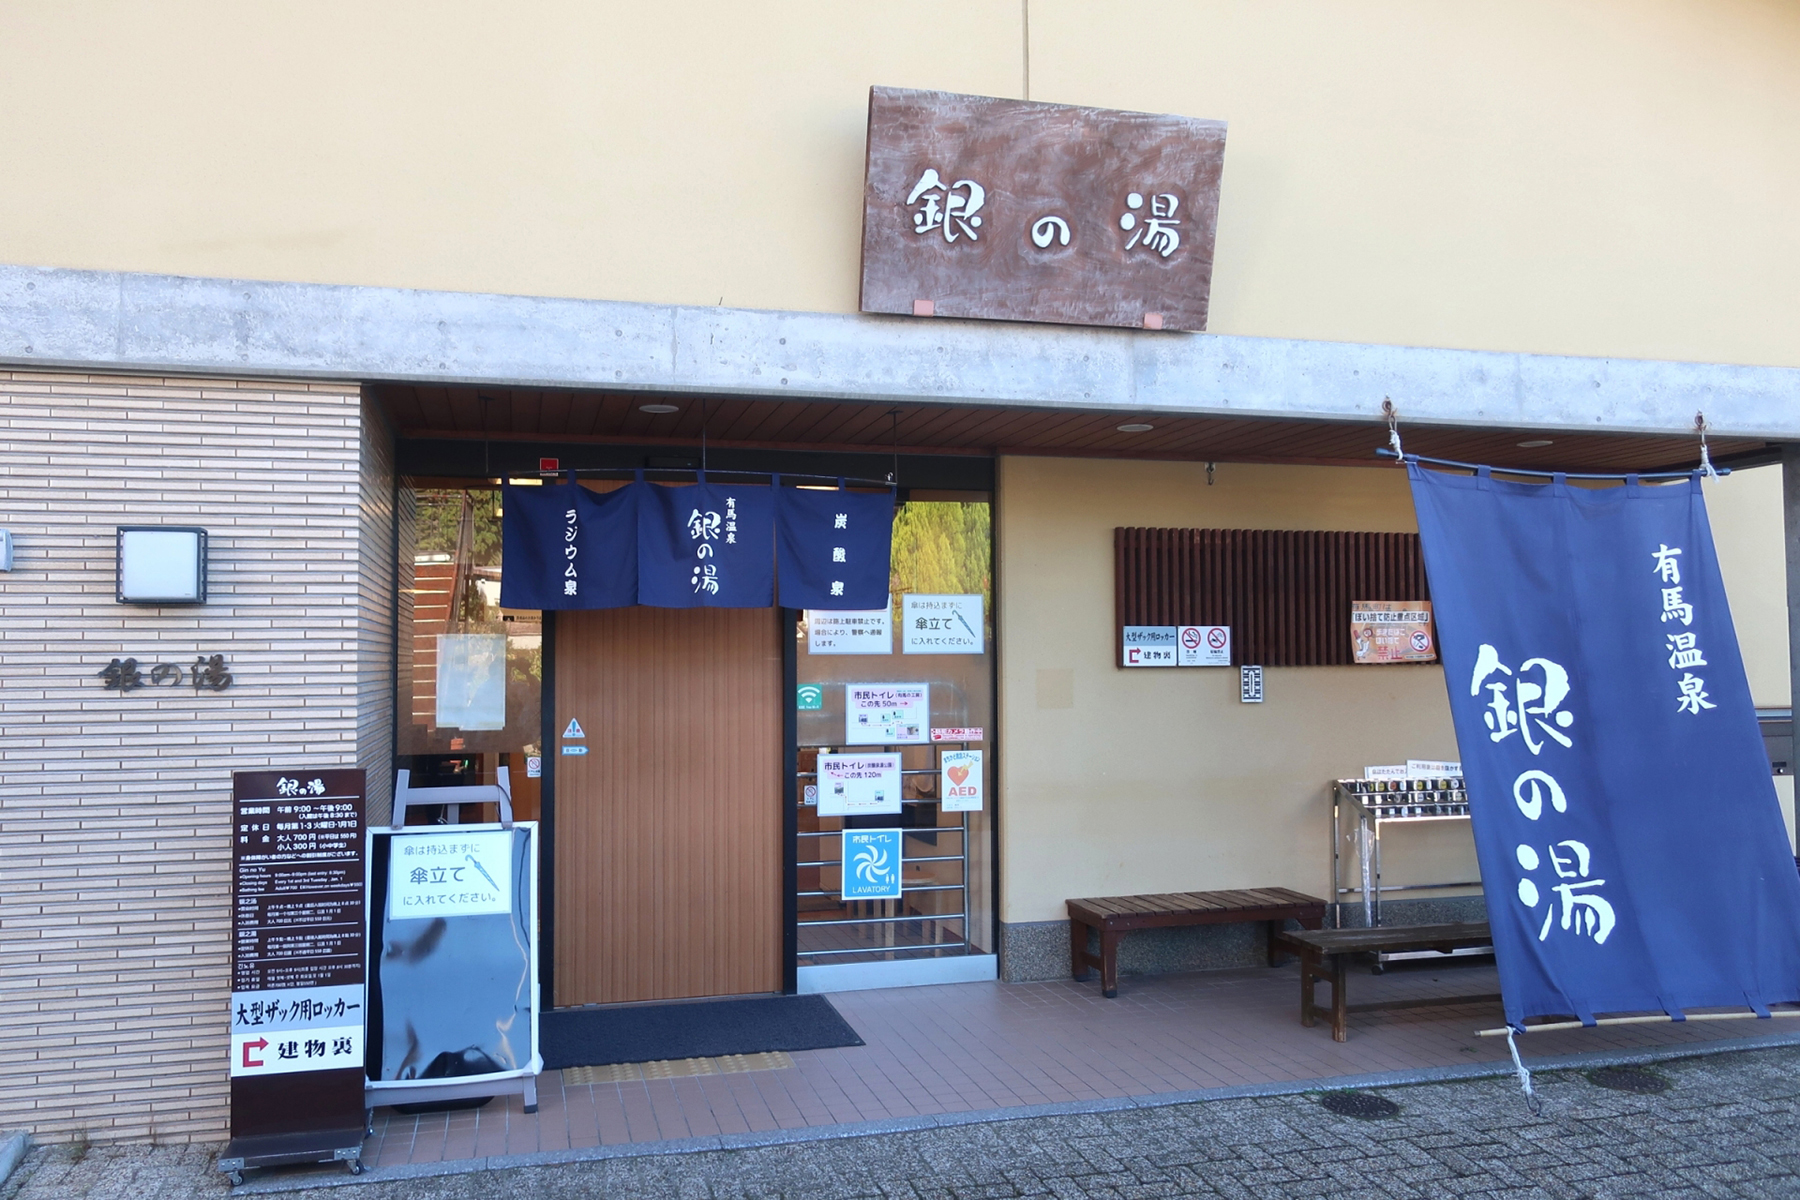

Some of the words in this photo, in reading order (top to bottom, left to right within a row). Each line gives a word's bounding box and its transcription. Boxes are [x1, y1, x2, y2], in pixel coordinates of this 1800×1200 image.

[906, 168, 1181, 258] 銀の湯
[725, 497, 738, 545] 有馬温泉
[564, 509, 579, 597] ラジウム泉
[687, 508, 721, 596] 銀の湯
[829, 513, 848, 597] 炭酸泉
[915, 616, 953, 631] 傘立て
[1651, 543, 1717, 716] 有馬温泉
[911, 637, 973, 647] に入れてください。
[98, 654, 234, 692] 銀の湯
[854, 691, 894, 700] 市民トイレ
[824, 762, 865, 771] 市民トイレ
[276, 777, 326, 797] 銀の湯
[948, 786, 977, 797] AED
[1470, 643, 1617, 945] 銀の湯
[851, 834, 893, 844] 市民トイレ
[403, 843, 481, 856] 傘は持込まずに
[409, 865, 466, 885] 傘立て
[402, 892, 497, 906] に入れてください。
[852, 885, 891, 894] LAVATORY
[235, 998, 361, 1026] 大型ザック用ロッカー
[277, 1037, 353, 1061] 建物裏
